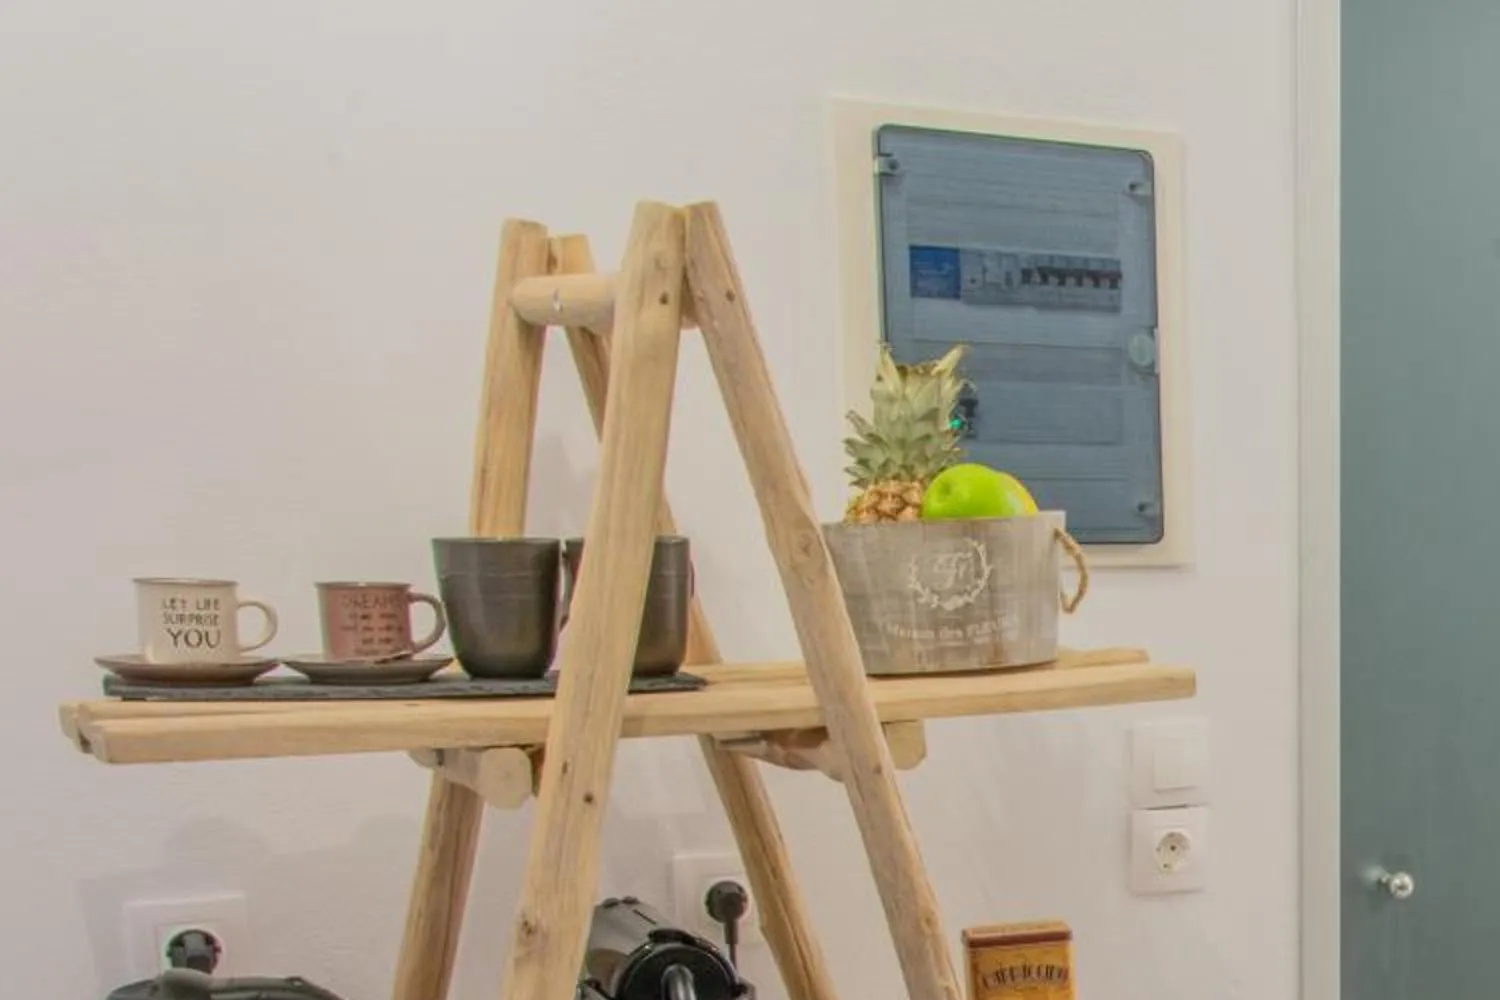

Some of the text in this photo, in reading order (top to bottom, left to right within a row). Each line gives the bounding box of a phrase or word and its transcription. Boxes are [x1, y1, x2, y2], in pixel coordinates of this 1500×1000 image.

[162, 597, 220, 610] LET LIFE
[163, 611, 219, 626] SURPRISE
[166, 628, 221, 649] YOU
